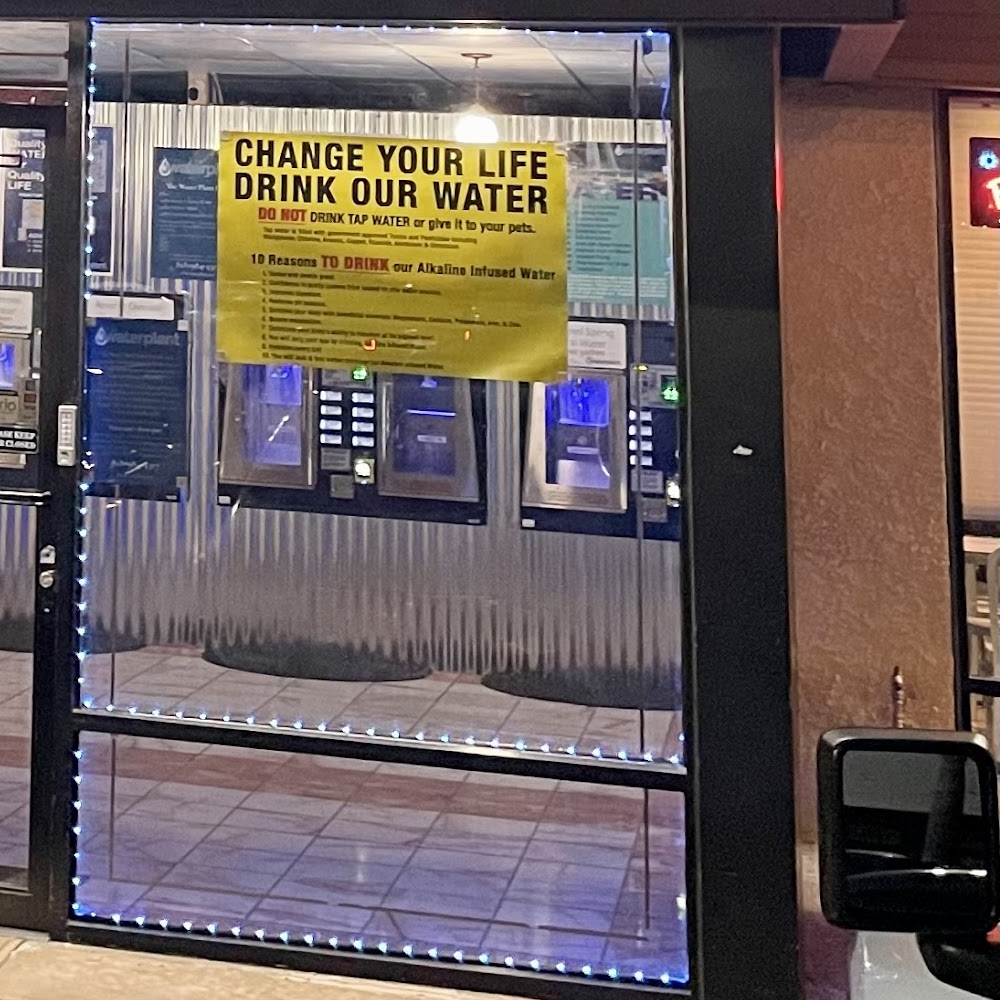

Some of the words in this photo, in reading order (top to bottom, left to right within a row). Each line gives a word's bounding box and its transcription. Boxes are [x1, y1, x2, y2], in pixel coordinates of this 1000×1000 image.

[235, 138, 364, 171] CHANGE
[377, 145, 463, 175] YOUR
[479, 149, 548, 180] LIFE
[8, 180, 32, 191] LIFE
[235, 172, 337, 204] DRINK
[352, 178, 417, 208] OUR
[433, 181, 548, 214] WATER
[258, 207, 276, 220] DO
[281, 208, 308, 222] NOT
[310, 211, 345, 224] DRINK
[347, 213, 369, 225] TAP
[371, 215, 410, 228] WATER
[413, 219, 425, 228] or
[428, 218, 451, 231] give
[465, 220, 477, 230] to
[480, 222, 506, 234] your
[508, 222, 537, 235] pets.
[251, 253, 265, 265] 10
[268, 254, 317, 268] Reasons
[321, 255, 339, 269] TO
[344, 256, 390, 272] DRINK
[393, 262, 413, 273] our
[417, 262, 466, 276] Alkaline
[470, 264, 516, 279] Infused
[520, 266, 556, 281] Water
